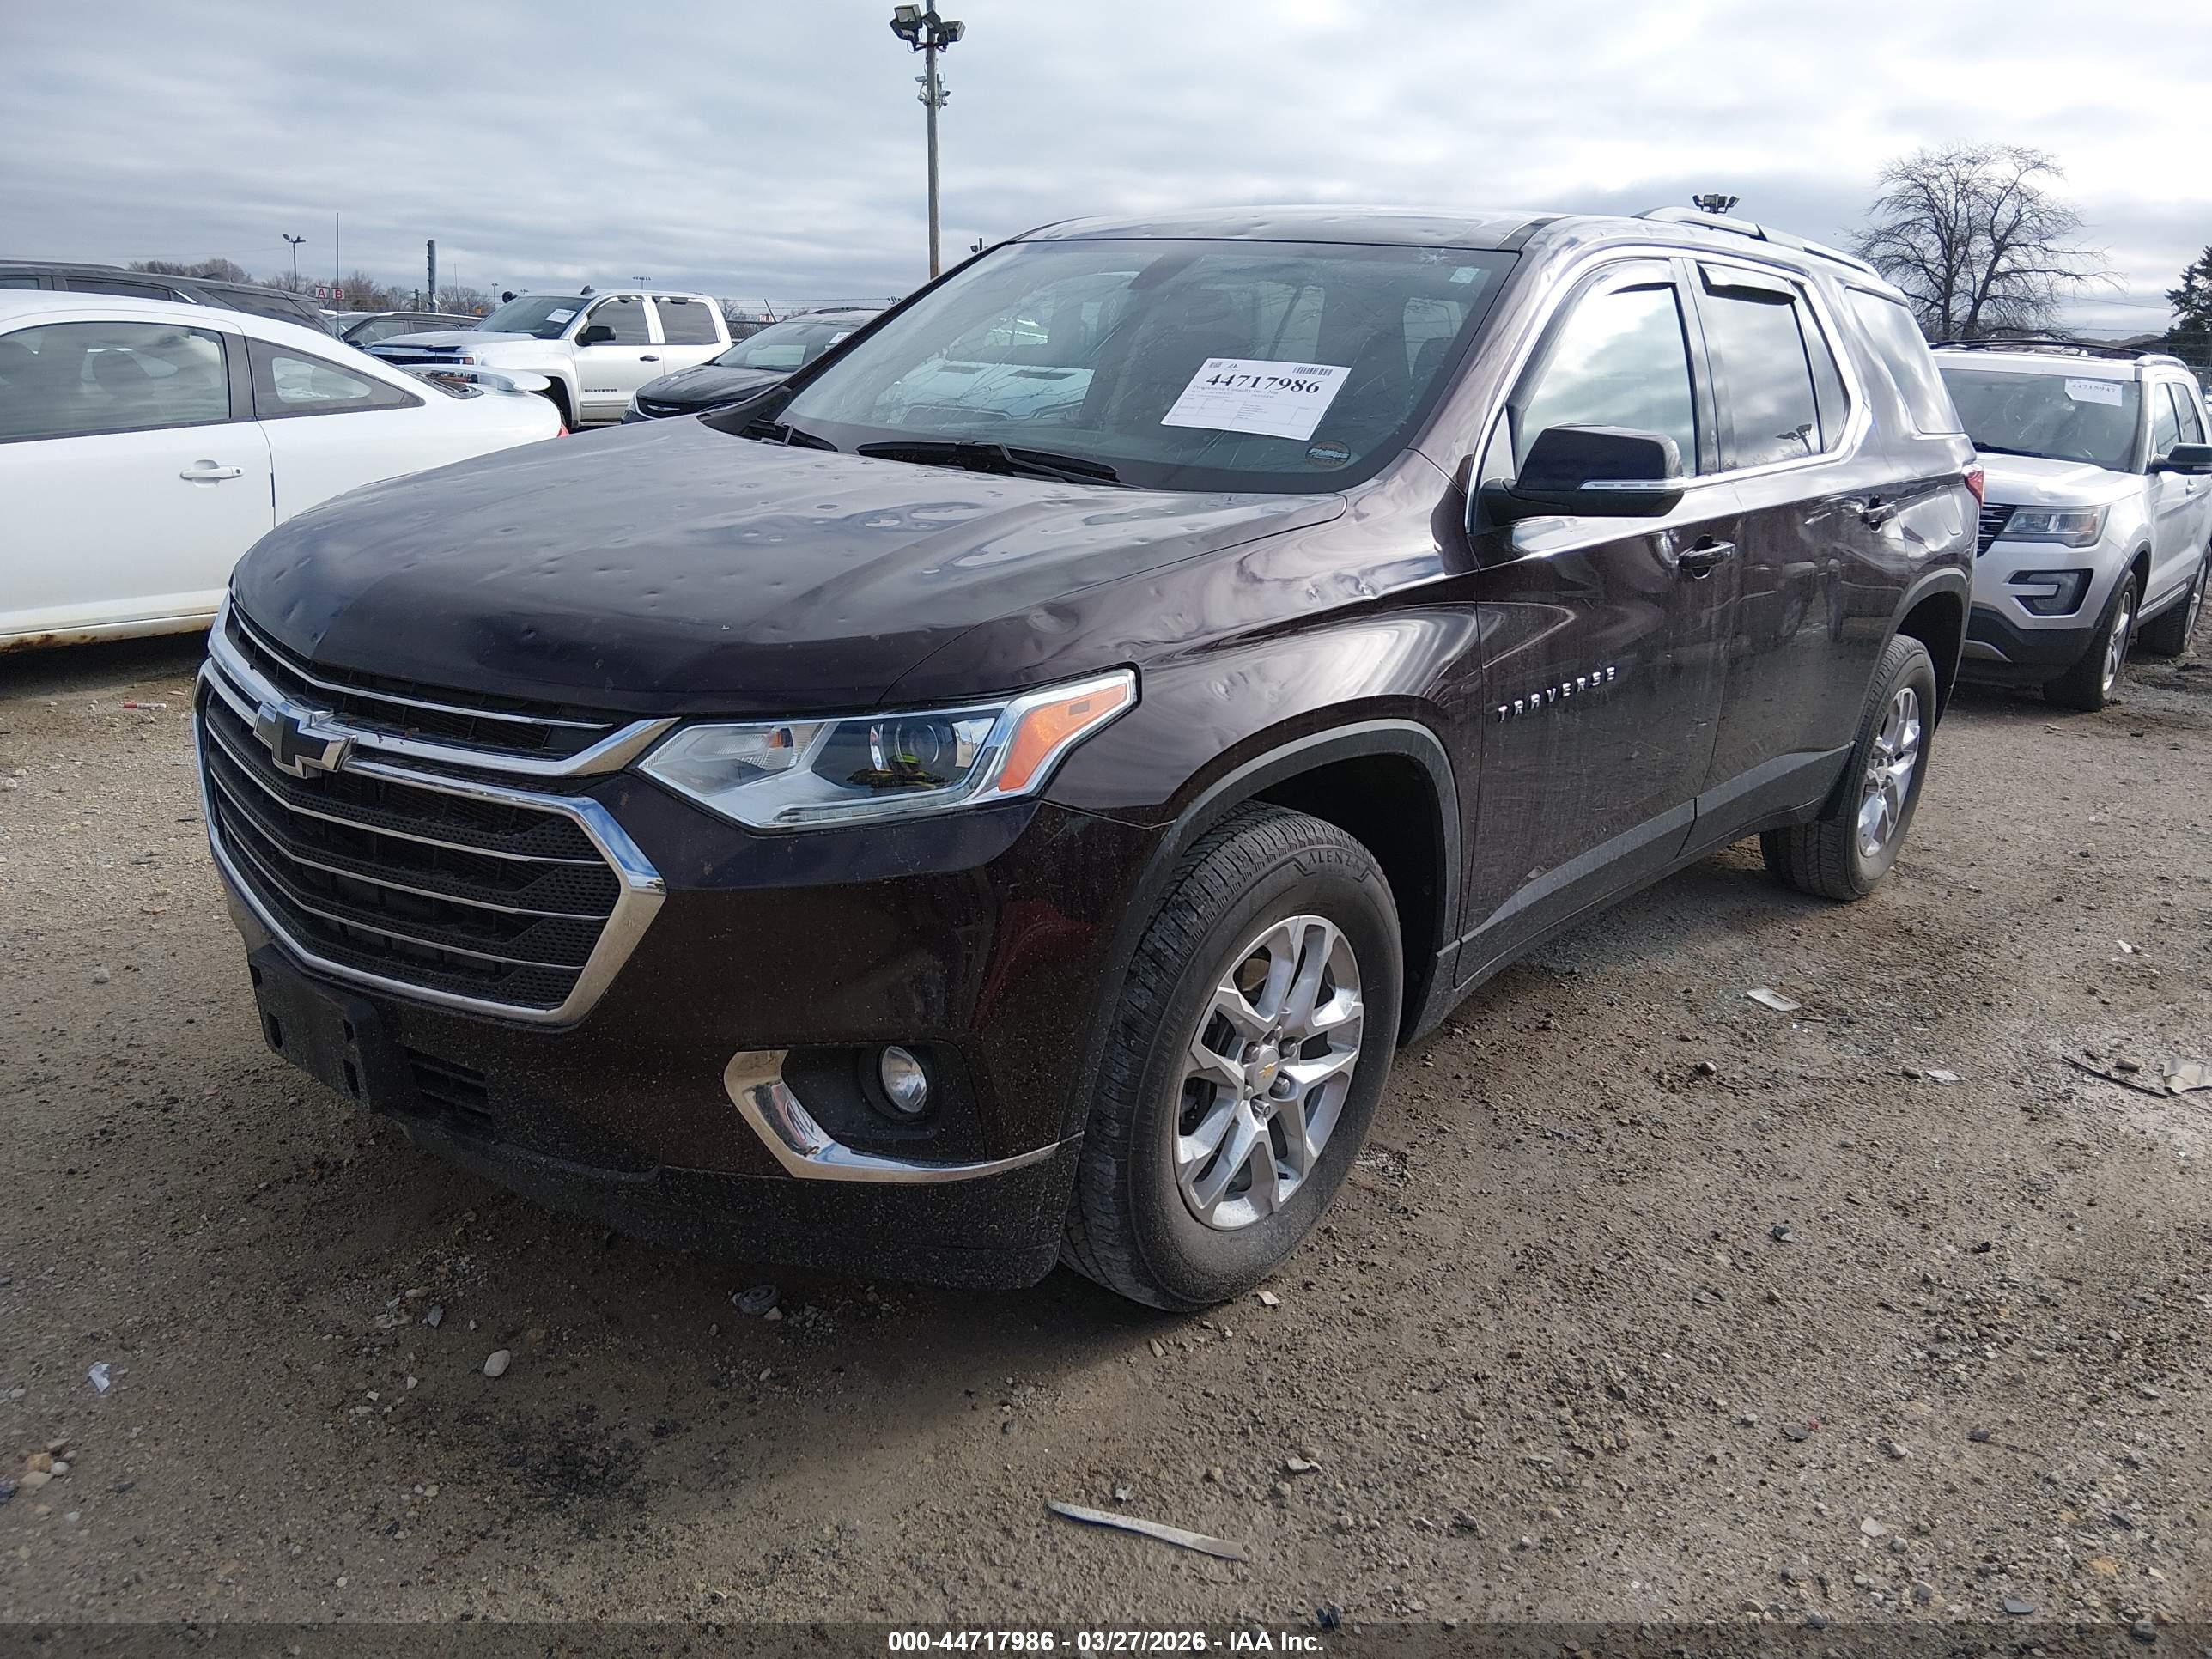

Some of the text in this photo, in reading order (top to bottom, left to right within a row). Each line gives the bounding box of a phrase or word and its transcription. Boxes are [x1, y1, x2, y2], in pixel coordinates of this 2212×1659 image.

[318, 288, 325, 297] A
[335, 289, 343, 298] B
[1206, 373, 1324, 394] 44717986
[1498, 666, 1615, 723] TRAVERSE
[1308, 850, 1360, 871] ALENZA
